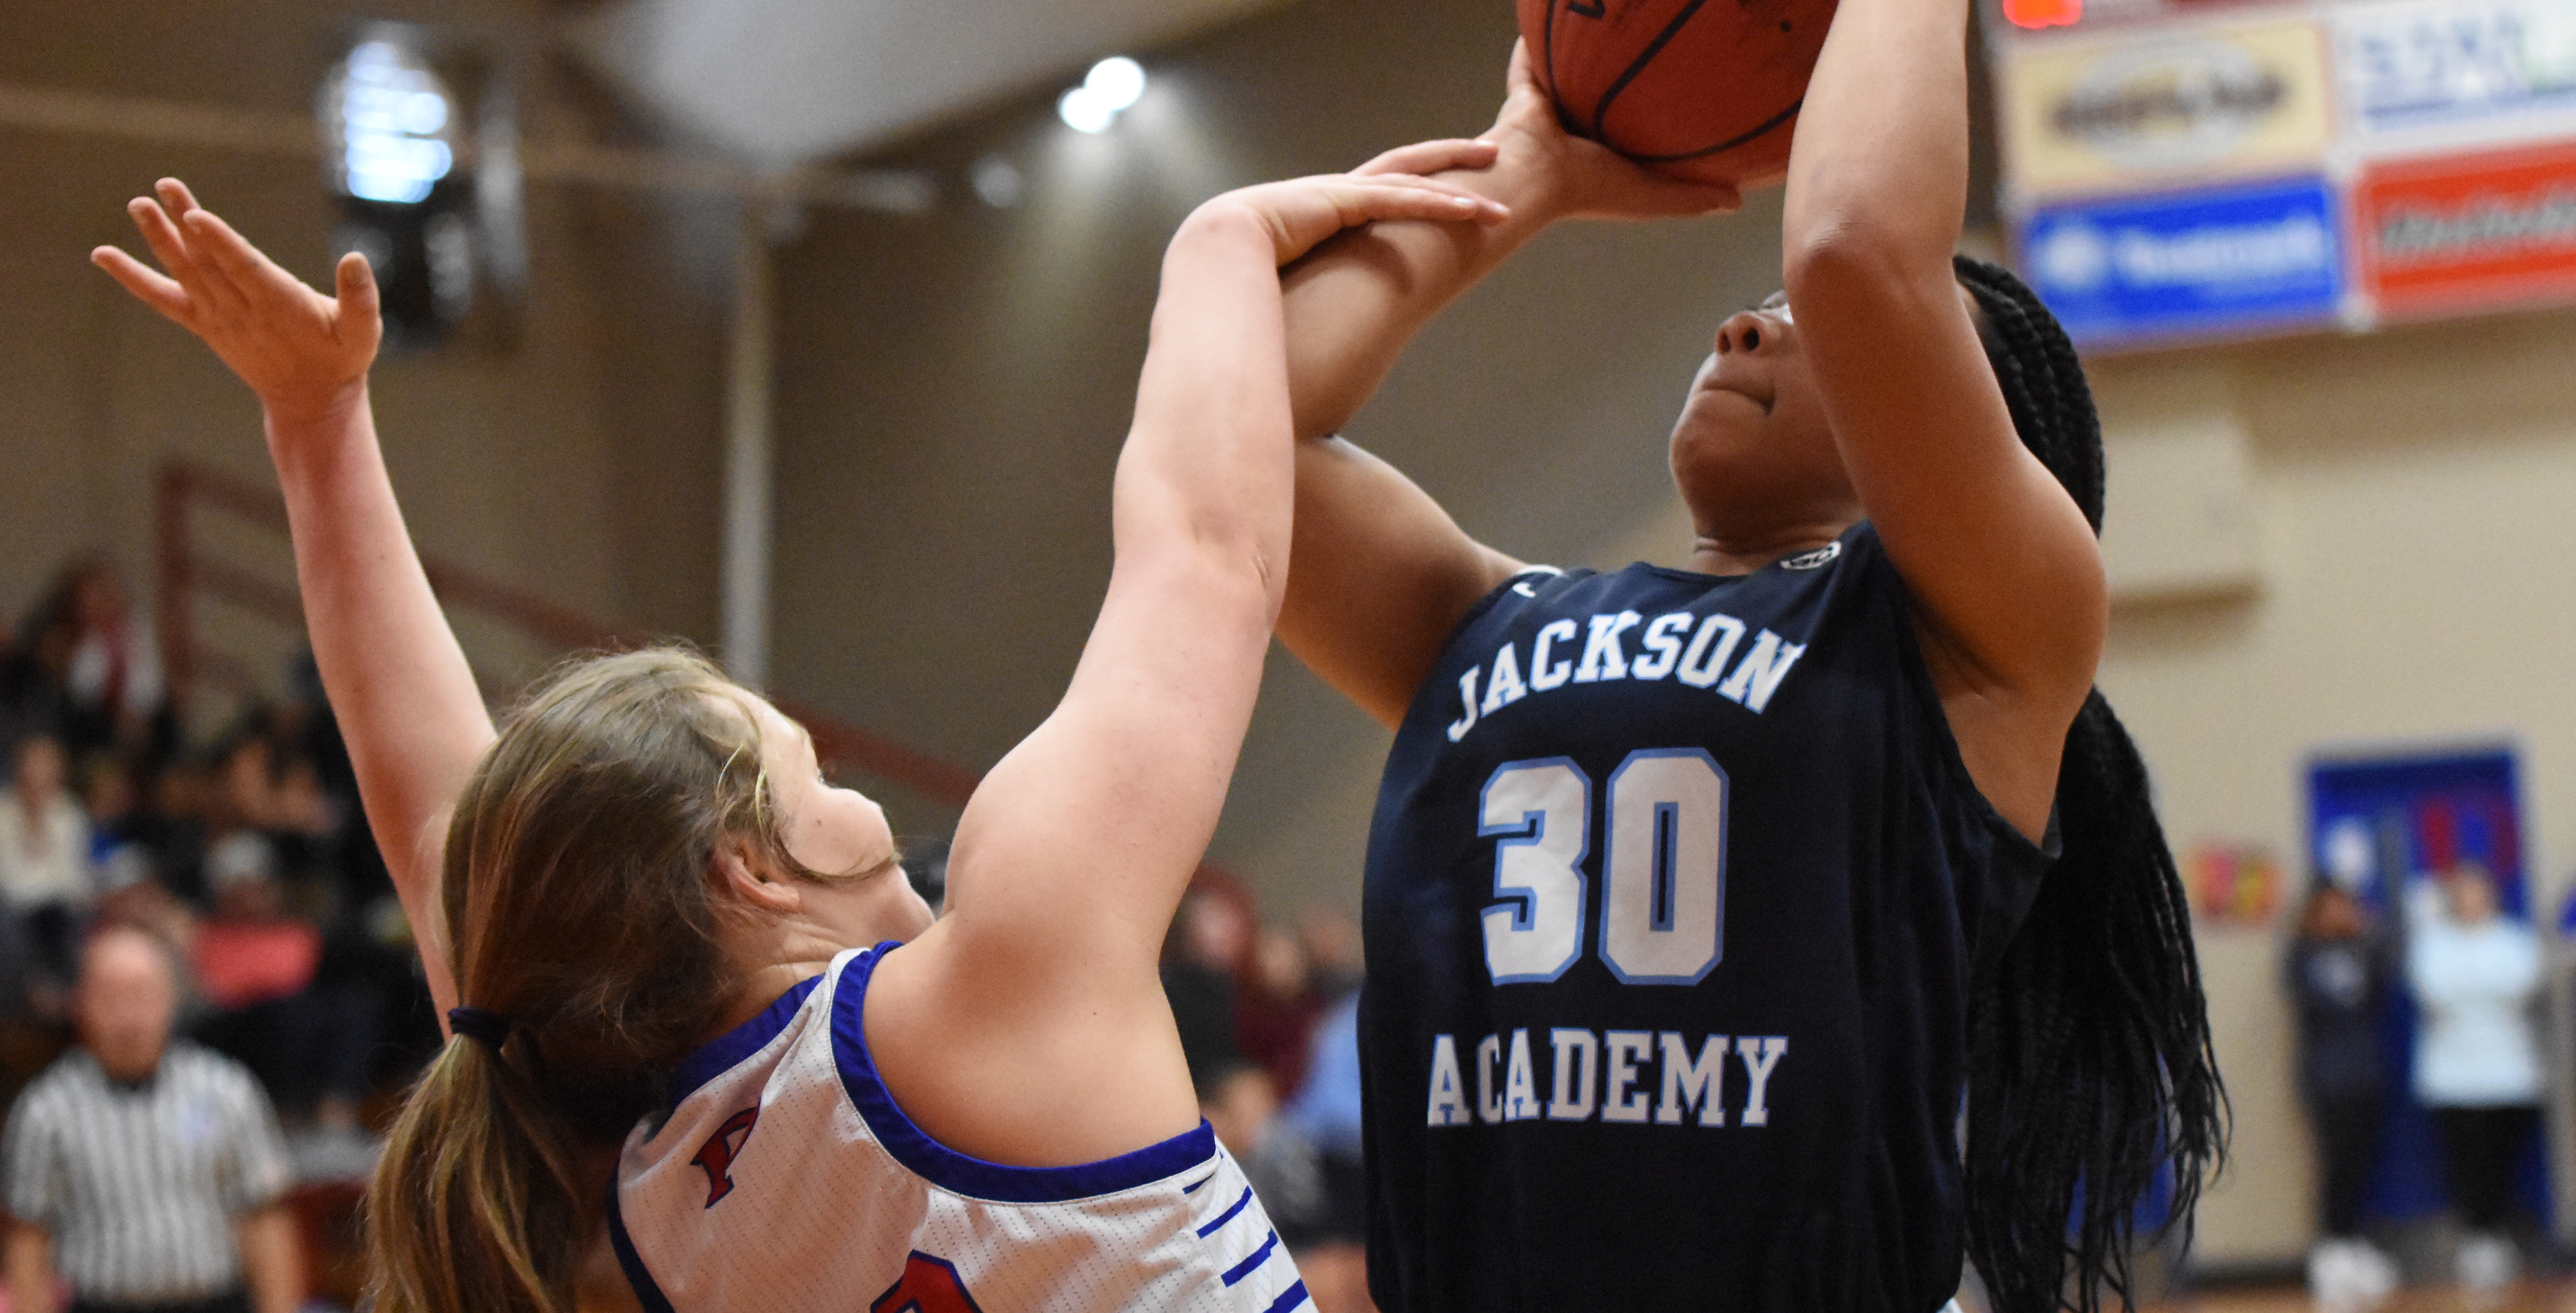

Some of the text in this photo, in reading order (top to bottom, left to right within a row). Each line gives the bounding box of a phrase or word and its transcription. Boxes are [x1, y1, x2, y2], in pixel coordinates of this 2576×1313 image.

[1447, 610, 1806, 743] JACKSON
[1477, 747, 1730, 987] 30
[1427, 1027, 1788, 1128] ACADEMY
